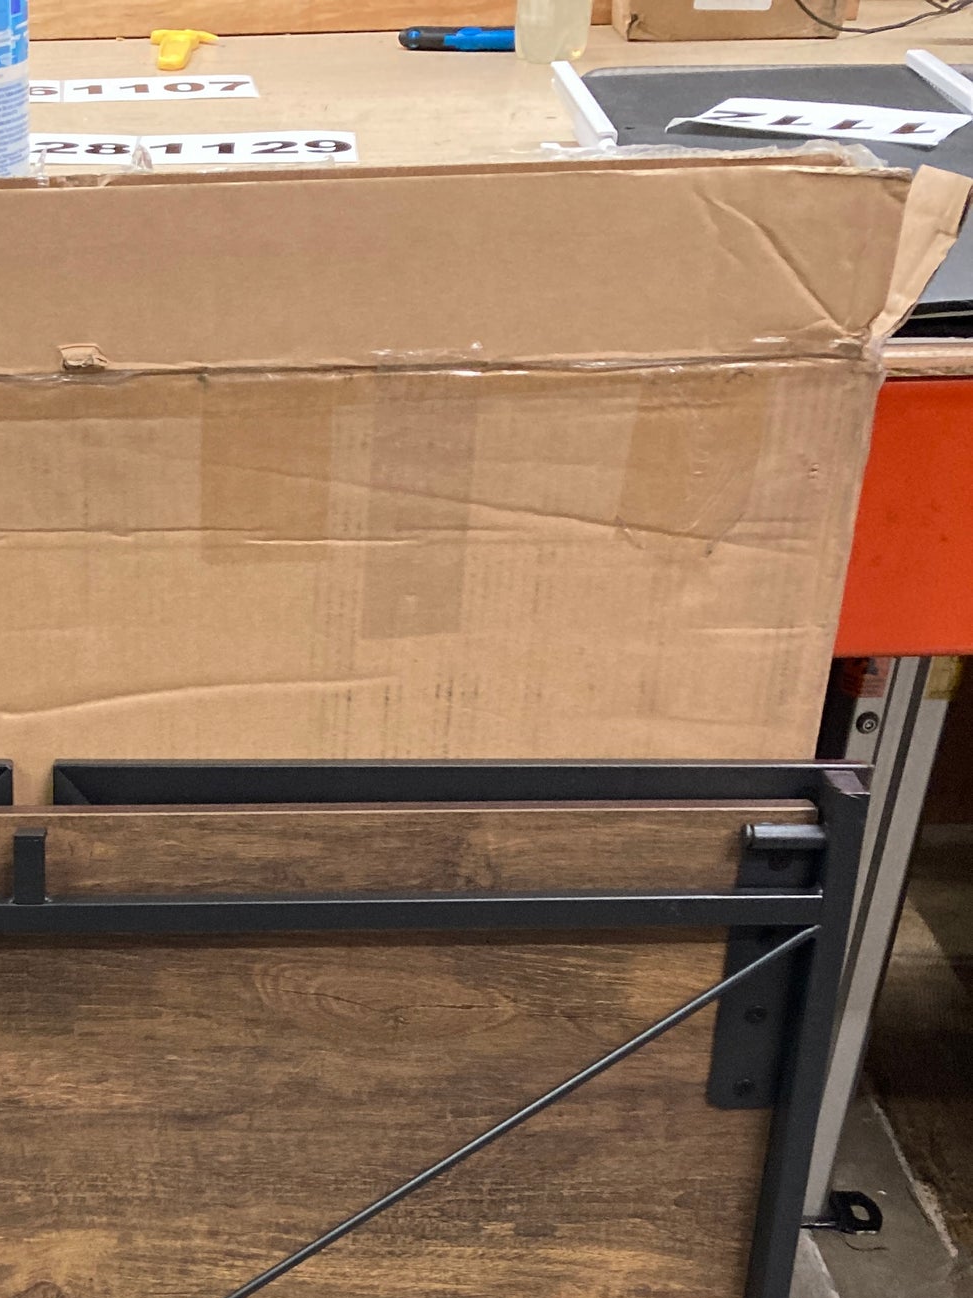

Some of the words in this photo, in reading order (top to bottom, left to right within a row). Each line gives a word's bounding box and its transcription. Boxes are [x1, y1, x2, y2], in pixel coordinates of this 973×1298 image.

[73, 80, 251, 95] 1107
[30, 141, 131, 154] 28
[149, 139, 353, 154] 1129
